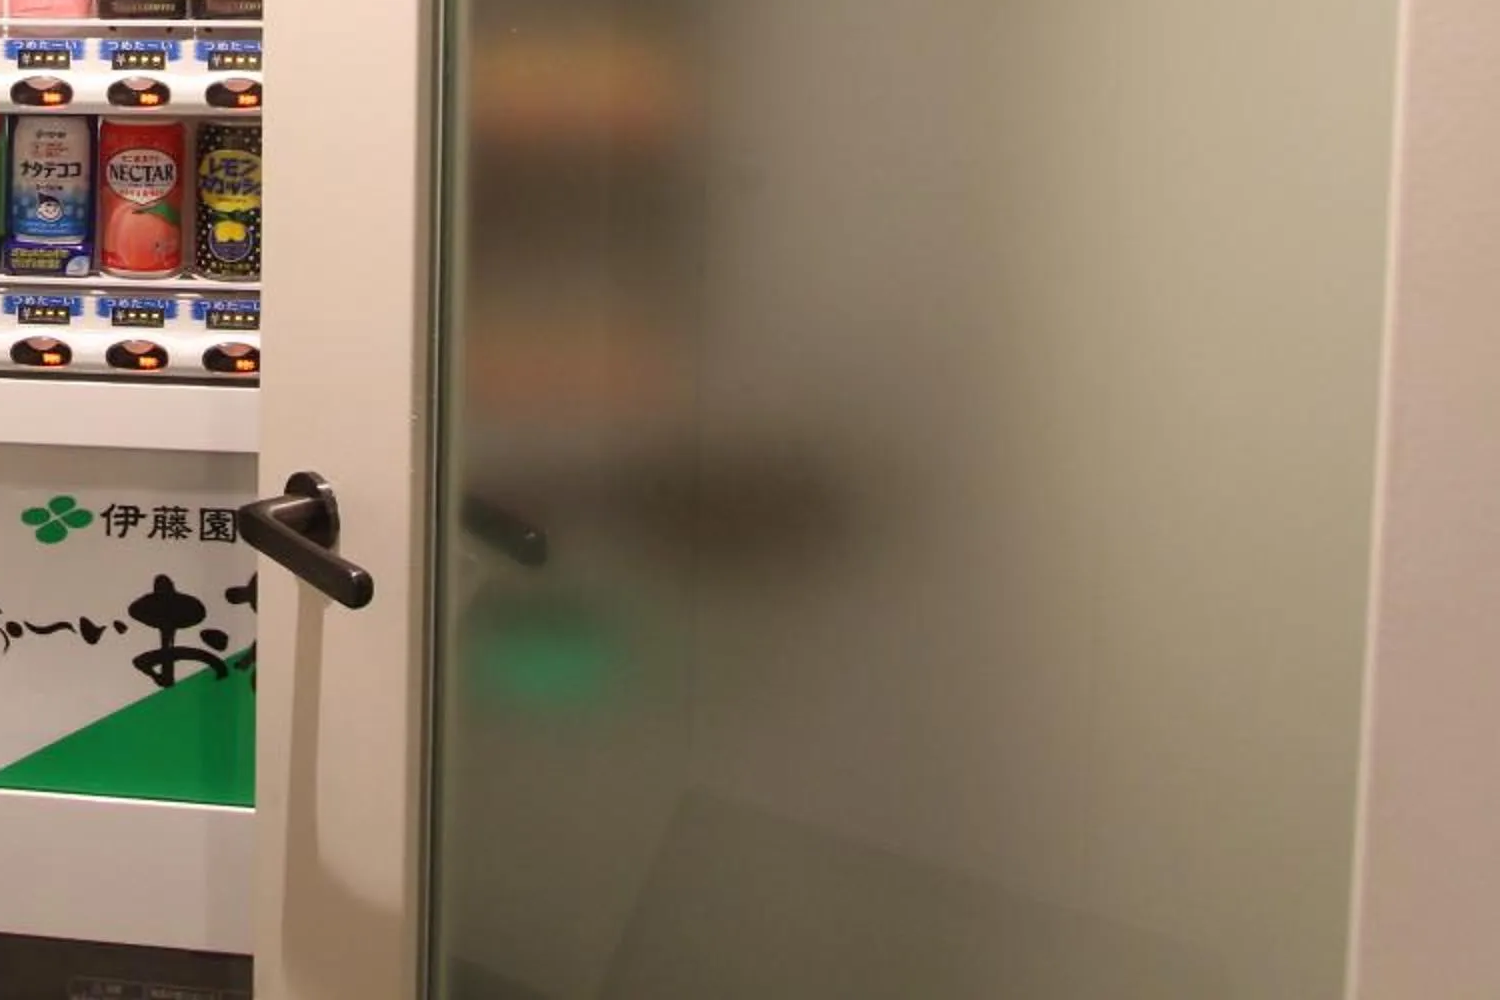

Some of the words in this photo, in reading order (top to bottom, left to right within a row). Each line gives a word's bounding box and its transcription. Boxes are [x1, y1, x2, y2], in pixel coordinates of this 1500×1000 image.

[19, 159, 83, 179] ナタデココ
[109, 163, 174, 182] NECTAR
[99, 503, 238, 544] 伊藤園
